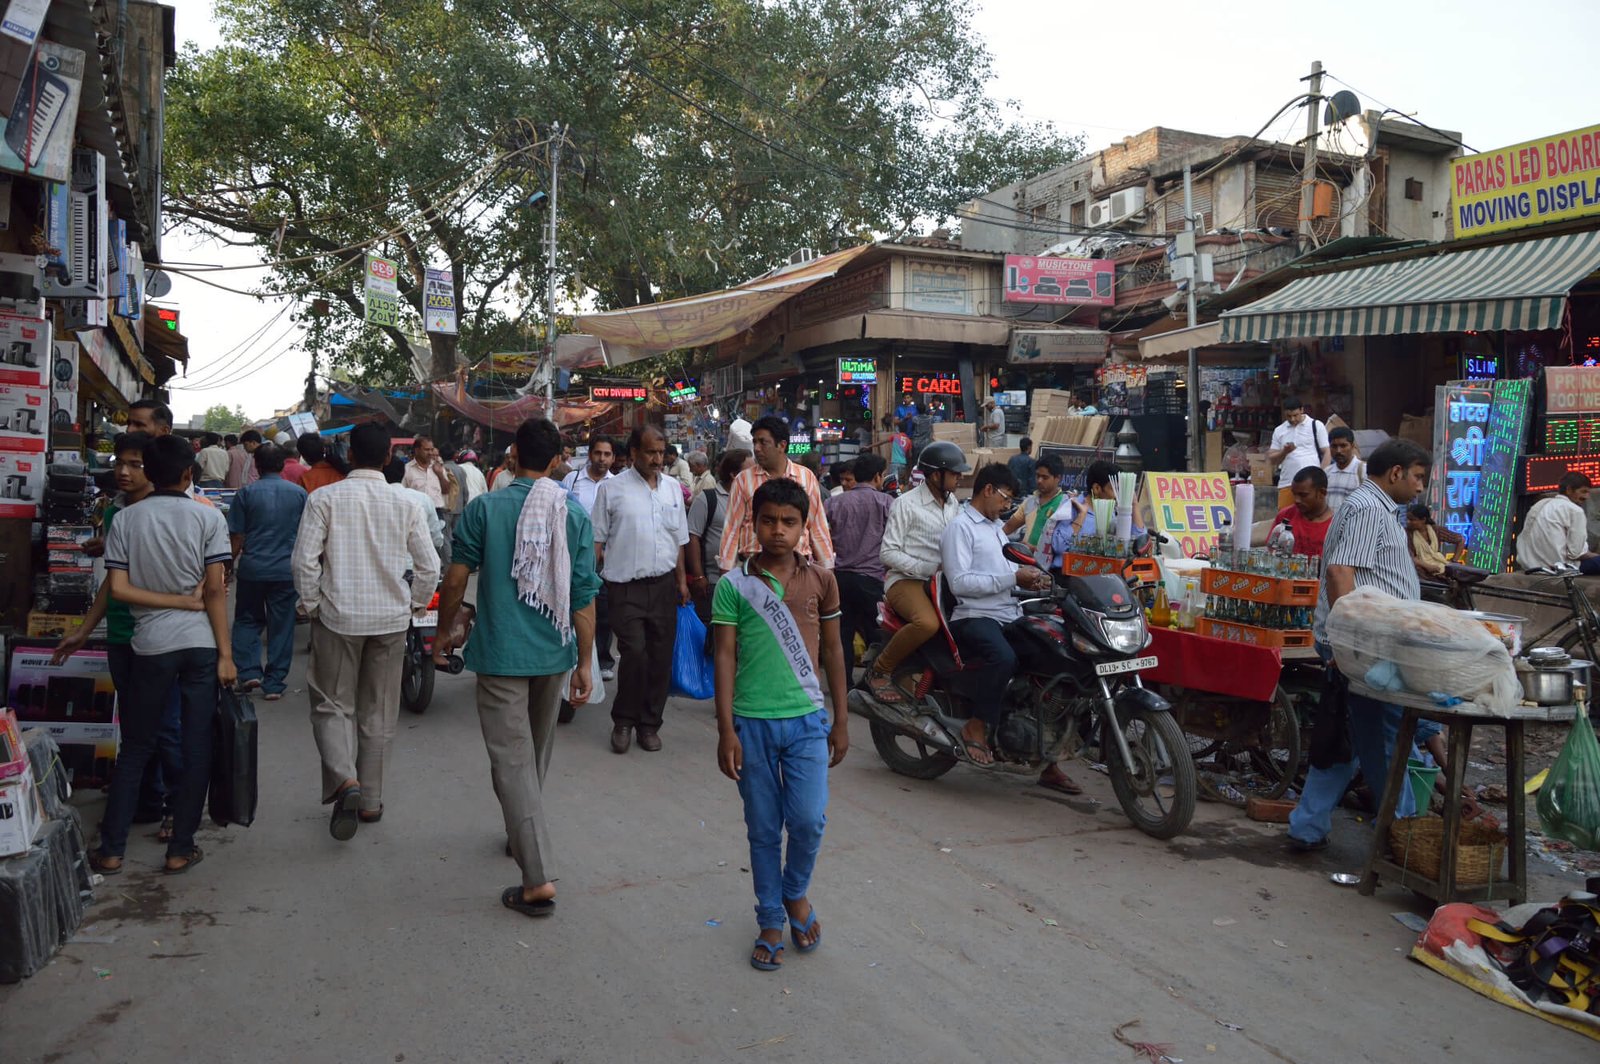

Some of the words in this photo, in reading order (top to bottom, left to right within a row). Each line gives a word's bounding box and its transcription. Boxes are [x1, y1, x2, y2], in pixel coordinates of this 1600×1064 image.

[1455, 154, 1506, 197] PARAS
[1510, 146, 1541, 185] LED
[1459, 192, 1531, 229] MOVING
[1037, 259, 1093, 272] MUSICTONE
[369, 298, 396, 312] CCTV
[1468, 359, 1496, 373] SLIM
[593, 387, 610, 397] CCTV
[1450, 426, 1486, 466] श्री
[1156, 477, 1227, 500] PARAS
[1162, 505, 1233, 530] LED
[1212, 575, 1230, 589] Crush
[1231, 578, 1250, 592] Crush
[1251, 581, 1270, 595] Crush
